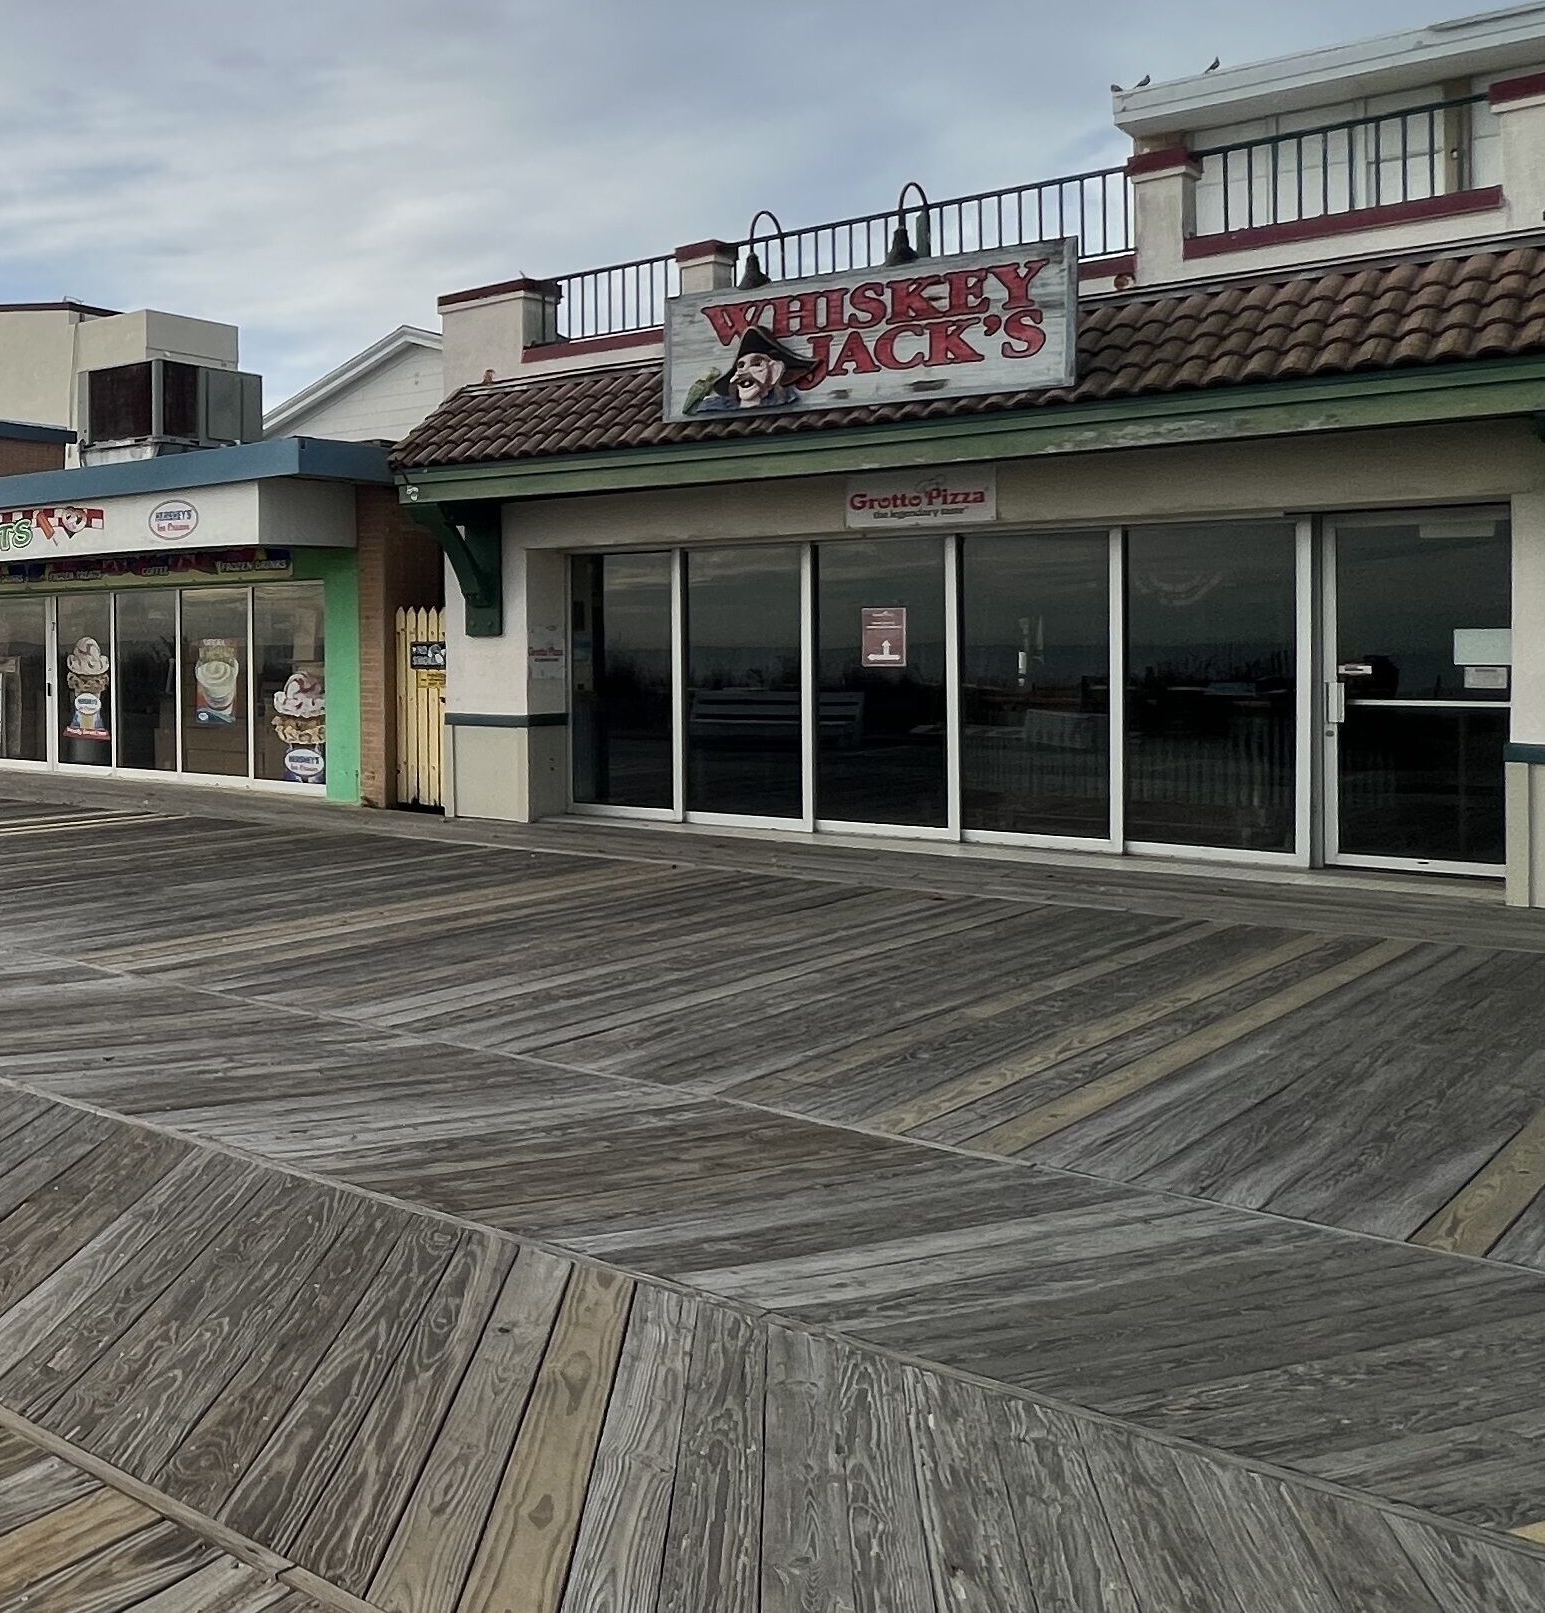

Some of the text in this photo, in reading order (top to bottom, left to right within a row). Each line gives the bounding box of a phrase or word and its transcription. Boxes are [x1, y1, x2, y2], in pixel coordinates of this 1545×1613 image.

[700, 257, 1050, 347] WHISKEY
[794, 308, 1048, 391] JACK'S
[850, 488, 986, 510] Grotto Pizza
